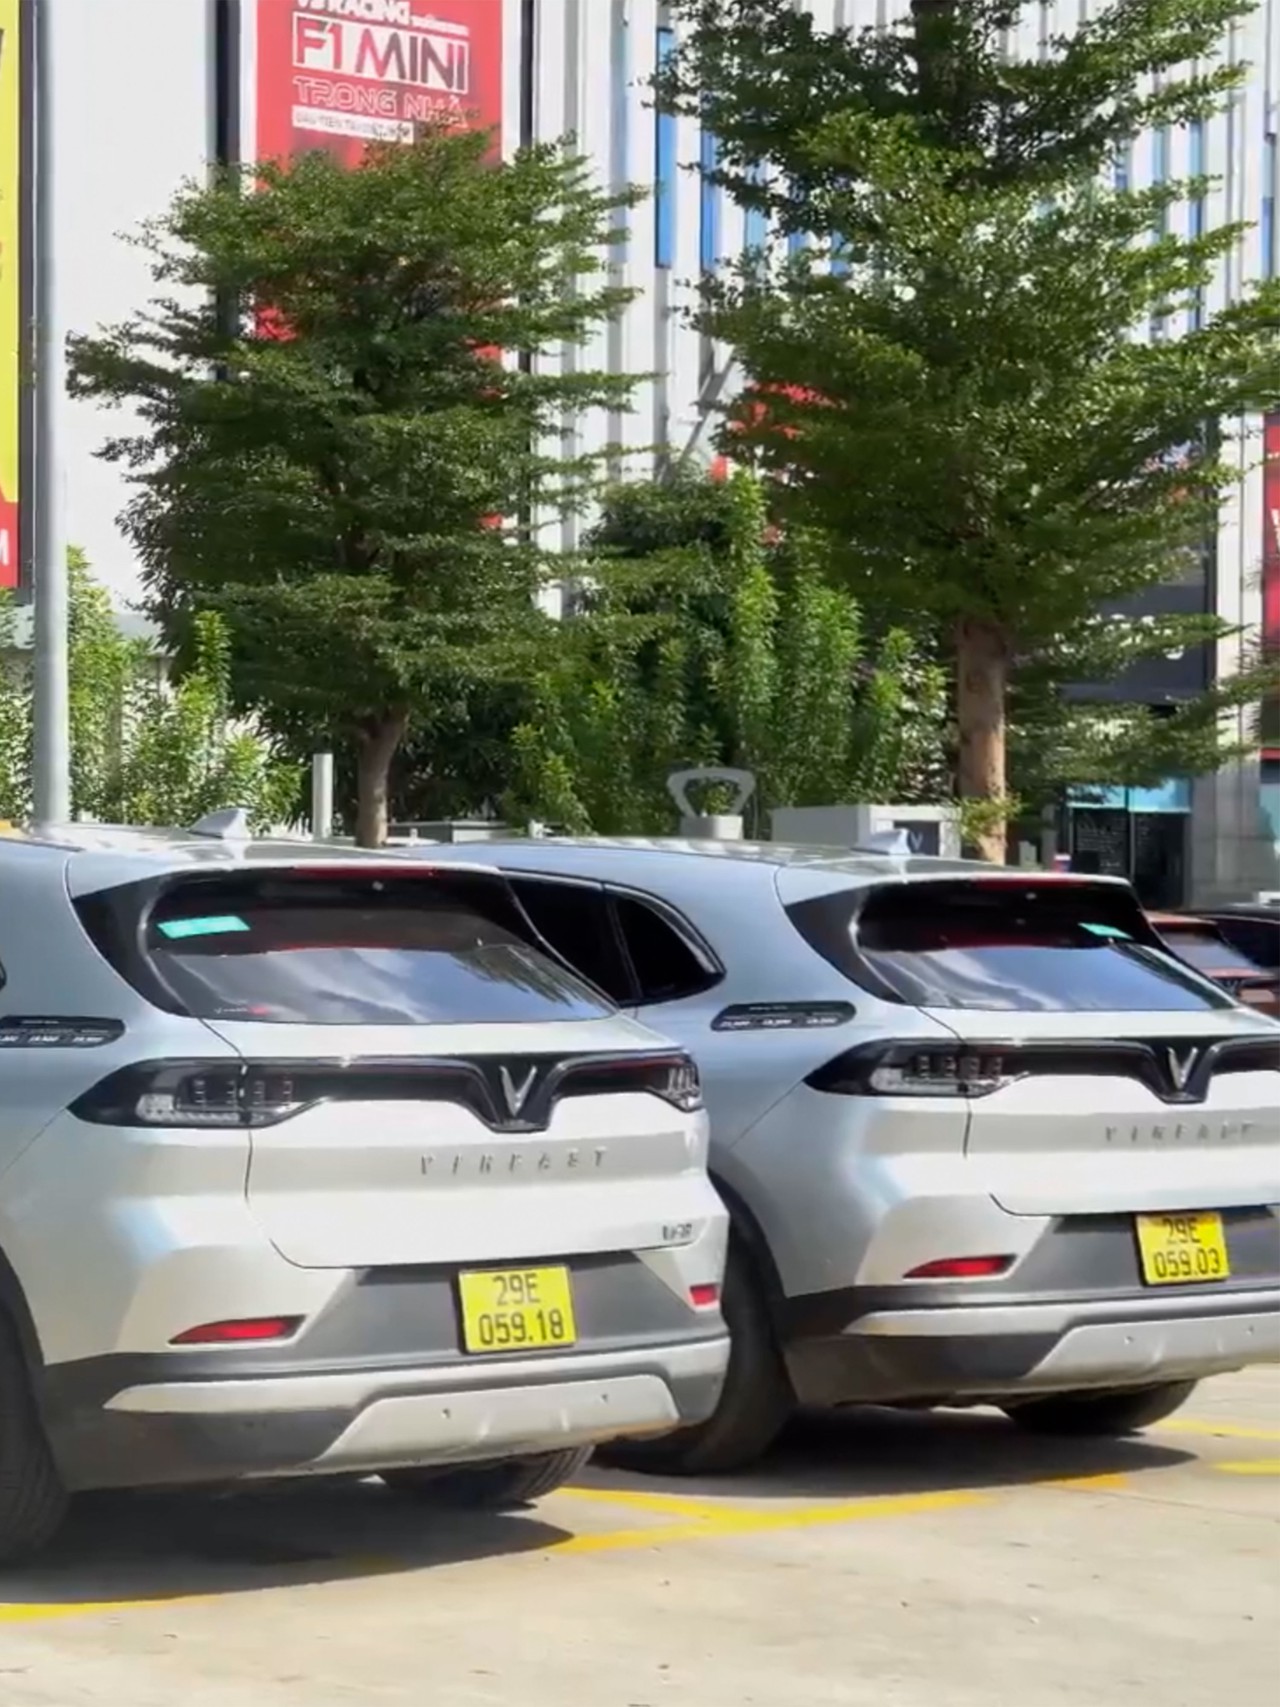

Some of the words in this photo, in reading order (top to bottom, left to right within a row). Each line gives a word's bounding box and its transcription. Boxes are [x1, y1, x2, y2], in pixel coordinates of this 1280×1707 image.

[296, 16, 343, 70] F1
[355, 28, 466, 91] MINI
[293, 76, 399, 116] TRONG
[1163, 1216, 1202, 1245] 29E
[1153, 1247, 1221, 1279] 059.03
[492, 1272, 542, 1307] 29E
[478, 1308, 565, 1346] 059.18
